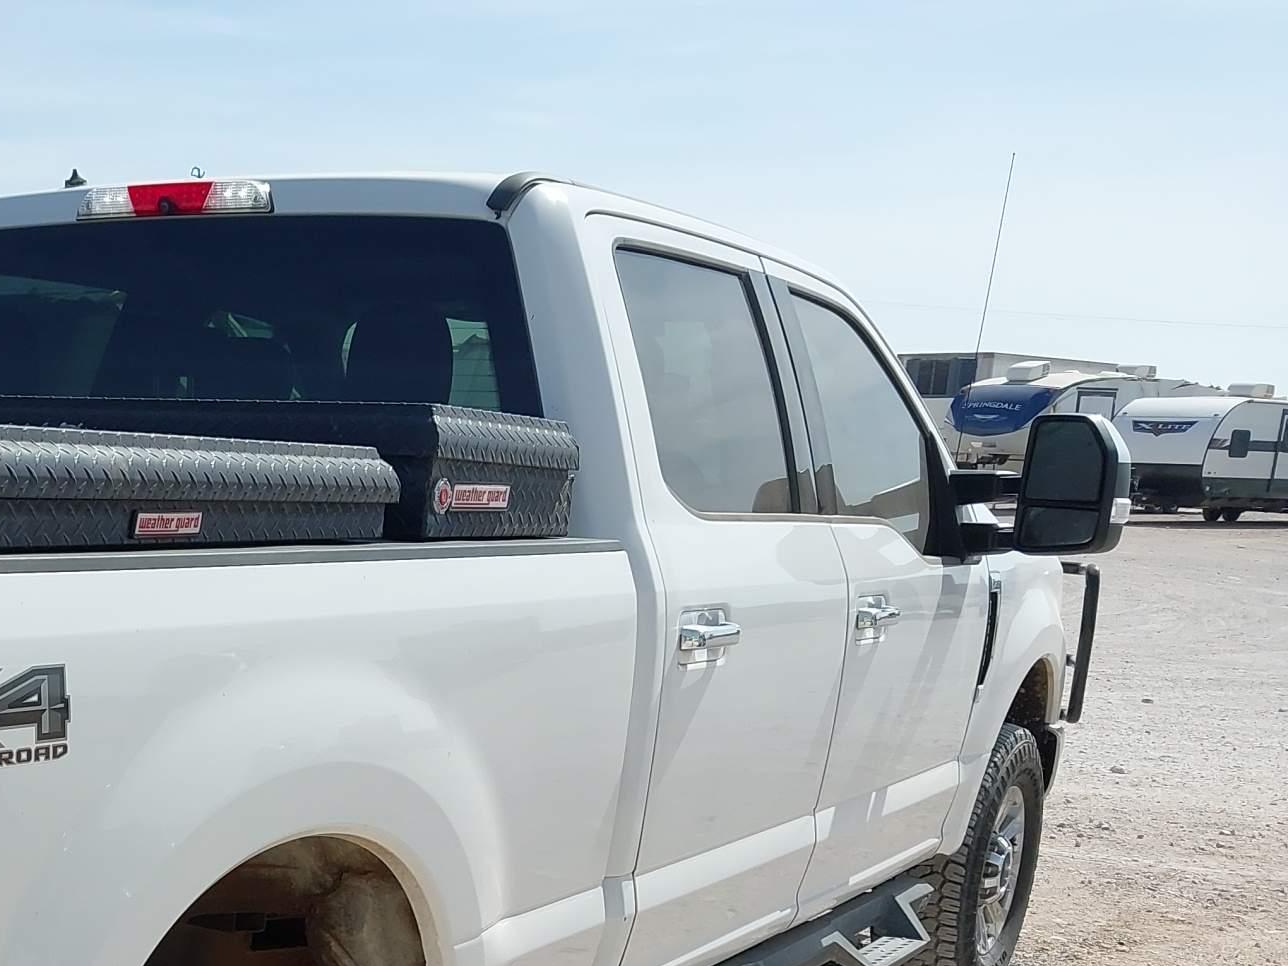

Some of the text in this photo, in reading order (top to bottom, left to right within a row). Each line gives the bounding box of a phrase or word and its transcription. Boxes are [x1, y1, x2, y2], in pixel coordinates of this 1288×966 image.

[455, 487, 508, 502] weather guard
[139, 514, 200, 529] weather guard
